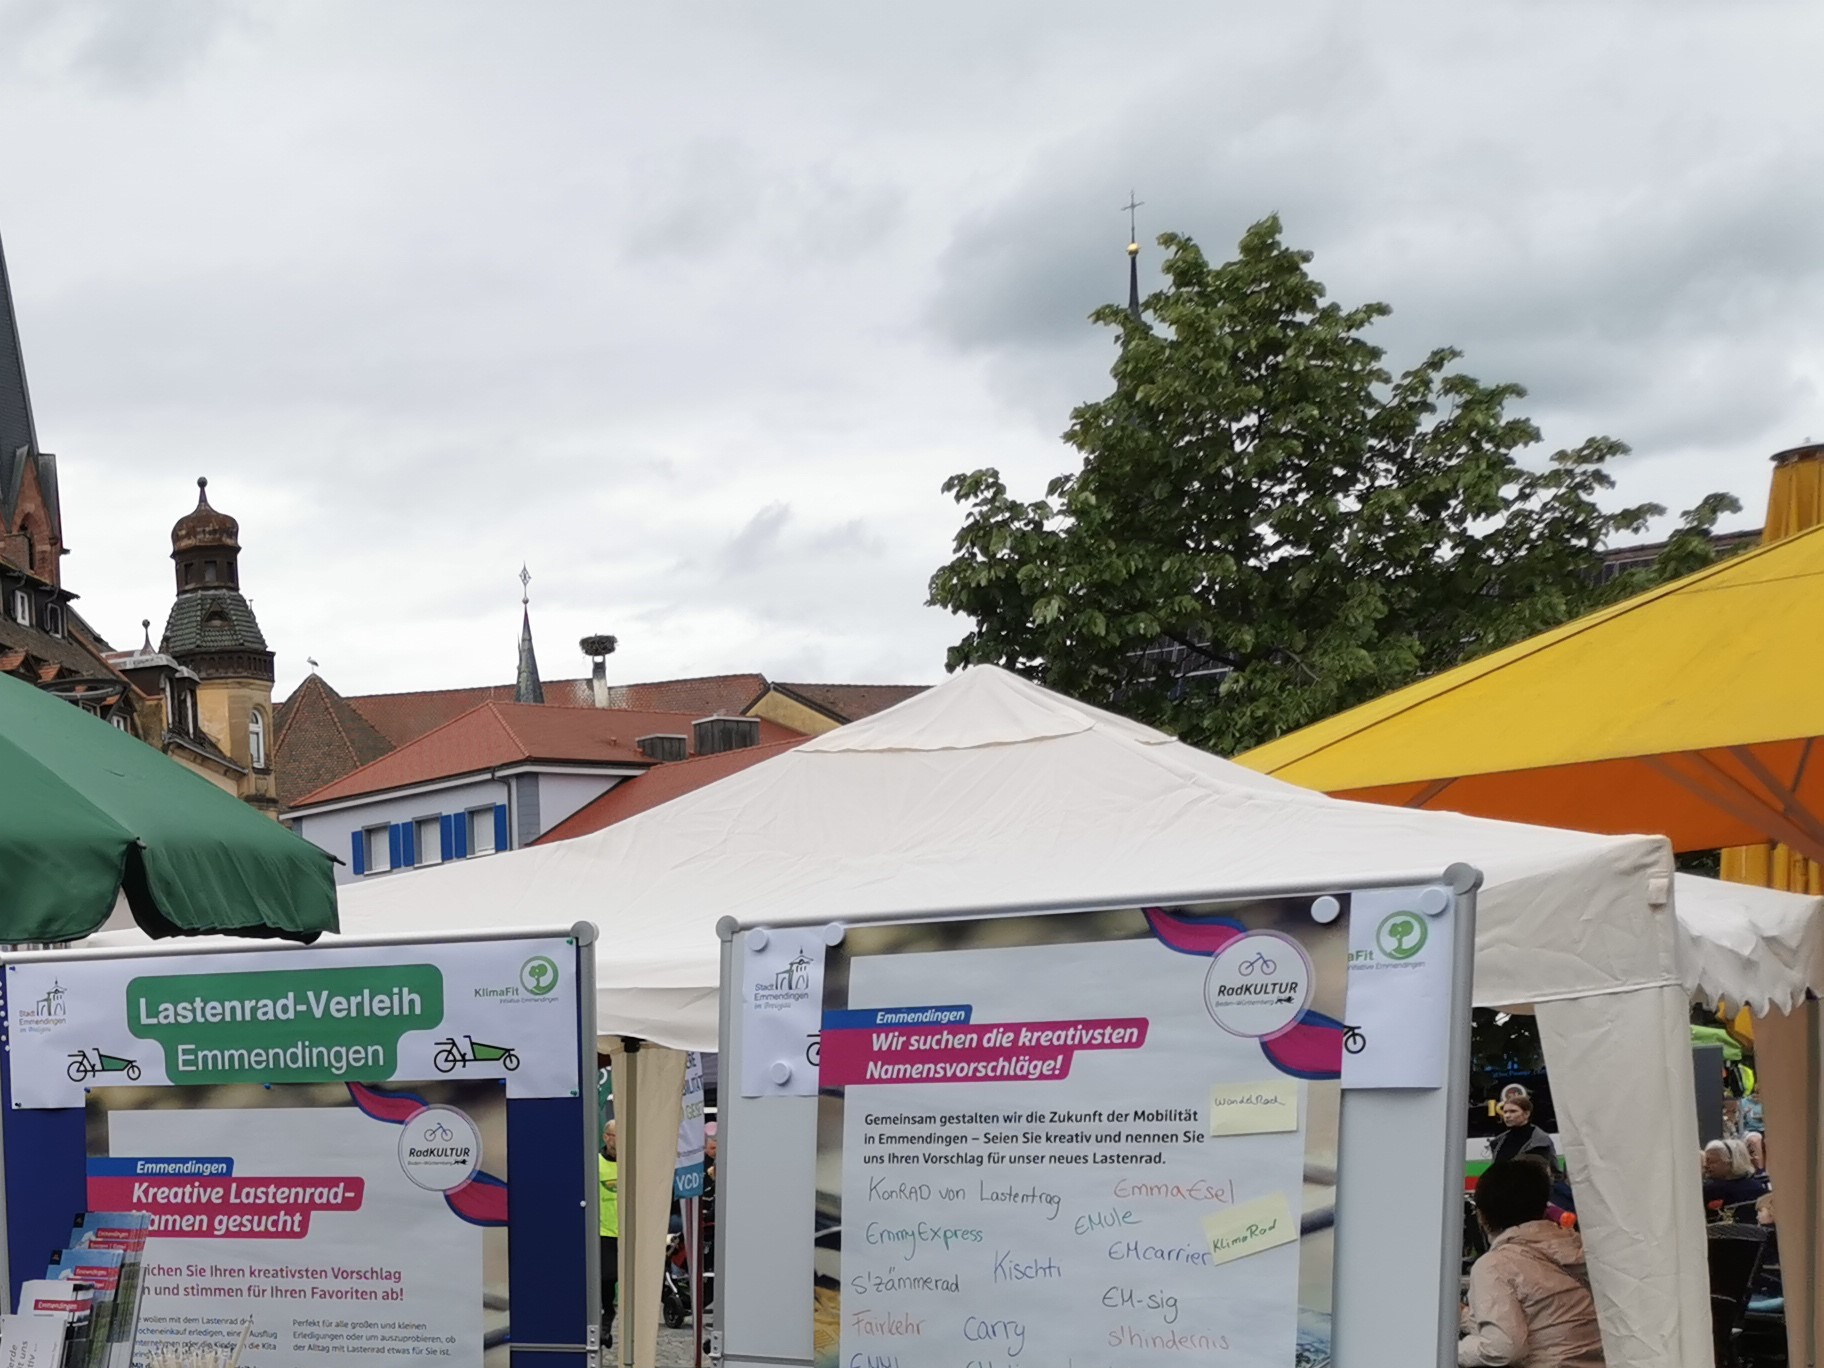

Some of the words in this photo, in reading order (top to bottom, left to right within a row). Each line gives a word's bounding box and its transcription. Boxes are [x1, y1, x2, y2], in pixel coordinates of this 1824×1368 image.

[474, 986, 519, 998] KlimaFit
[754, 992, 808, 1001] Emmendingen
[1218, 981, 1298, 997] RadKULTUR
[139, 986, 422, 1025] Lastenrad-Verleih
[876, 1009, 965, 1025] Emmendingen
[872, 1032, 906, 1051] Wir
[908, 1029, 978, 1050] suchen
[983, 1027, 1014, 1048] die
[1018, 1025, 1139, 1047] kreativsten
[177, 1040, 384, 1075] Emmendingen
[866, 1055, 1064, 1081] Namensvorschläge!
[864, 1113, 936, 1126] Gemeinsam
[939, 1112, 999, 1127] gestalten
[1003, 1112, 1022, 1124] wir
[1026, 1111, 1045, 1123] die
[1049, 1110, 1103, 1123] Zukunft
[1107, 1110, 1129, 1123] der
[1133, 1108, 1198, 1122] Mobilität
[864, 1133, 875, 1144] in
[878, 1132, 968, 1147] Emmendingen
[983, 1132, 1018, 1144] Seien
[1022, 1131, 1042, 1144] Sie
[1045, 1131, 1092, 1144] kreativ
[1095, 1130, 1121, 1143] und
[1125, 1132, 1178, 1143] nennen
[1183, 1130, 1205, 1143] Sie
[409, 1147, 470, 1157] RadKULTUR
[864, 1154, 885, 1164] uns
[888, 1152, 919, 1164] Ihren
[923, 1152, 984, 1167] Vorschlag
[987, 1152, 1006, 1164] für
[1009, 1154, 1046, 1164] unser
[1048, 1153, 1088, 1164] neues
[1093, 1152, 1166, 1165] Lastenrad.
[136, 1160, 226, 1176] Emmendingen
[132, 1181, 224, 1204] Kreative
[229, 1182, 356, 1204] Lastenrad-
[1113, 1178, 1235, 1204] EmmaEsel
[938, 1188, 966, 1201] von
[979, 1179, 1061, 1221] Lastentrag
[132, 1209, 208, 1231] amen
[214, 1210, 303, 1235] gesucht
[866, 1221, 984, 1261] EmmyExpress
[186, 1264, 206, 1277] Sie
[210, 1265, 246, 1278] Ihren
[249, 1266, 328, 1279] kreativsten
[331, 1267, 402, 1283] Vorschlag
[155, 1284, 180, 1297] und
[184, 1284, 243, 1298] stimmen
[247, 1285, 267, 1299] für
[271, 1286, 307, 1299] Ihren
[311, 1287, 377, 1301] Favoriten
[382, 1288, 404, 1301] ab!
[202, 1317, 238, 1325] Lastenrad
[293, 1319, 320, 1327] Perfekt
[322, 1319, 333, 1328] für
[335, 1320, 349, 1328] alle
[351, 1320, 379, 1330] großen
[381, 1322, 396, 1330] und
[398, 1322, 427, 1330] kleinen
[851, 1309, 926, 1336] Fairkehr
[249, 1330, 277, 1339] Ausflug
[293, 1331, 344, 1341] Erledigungen
[346, 1333, 364, 1341] oder
[380, 1334, 443, 1344] auszuprobieren,
[307, 1344, 330, 1354] Alltag
[347, 1345, 385, 1354] Lastenrad
[387, 1347, 410, 1355] etwas
[412, 1347, 424, 1355] für
